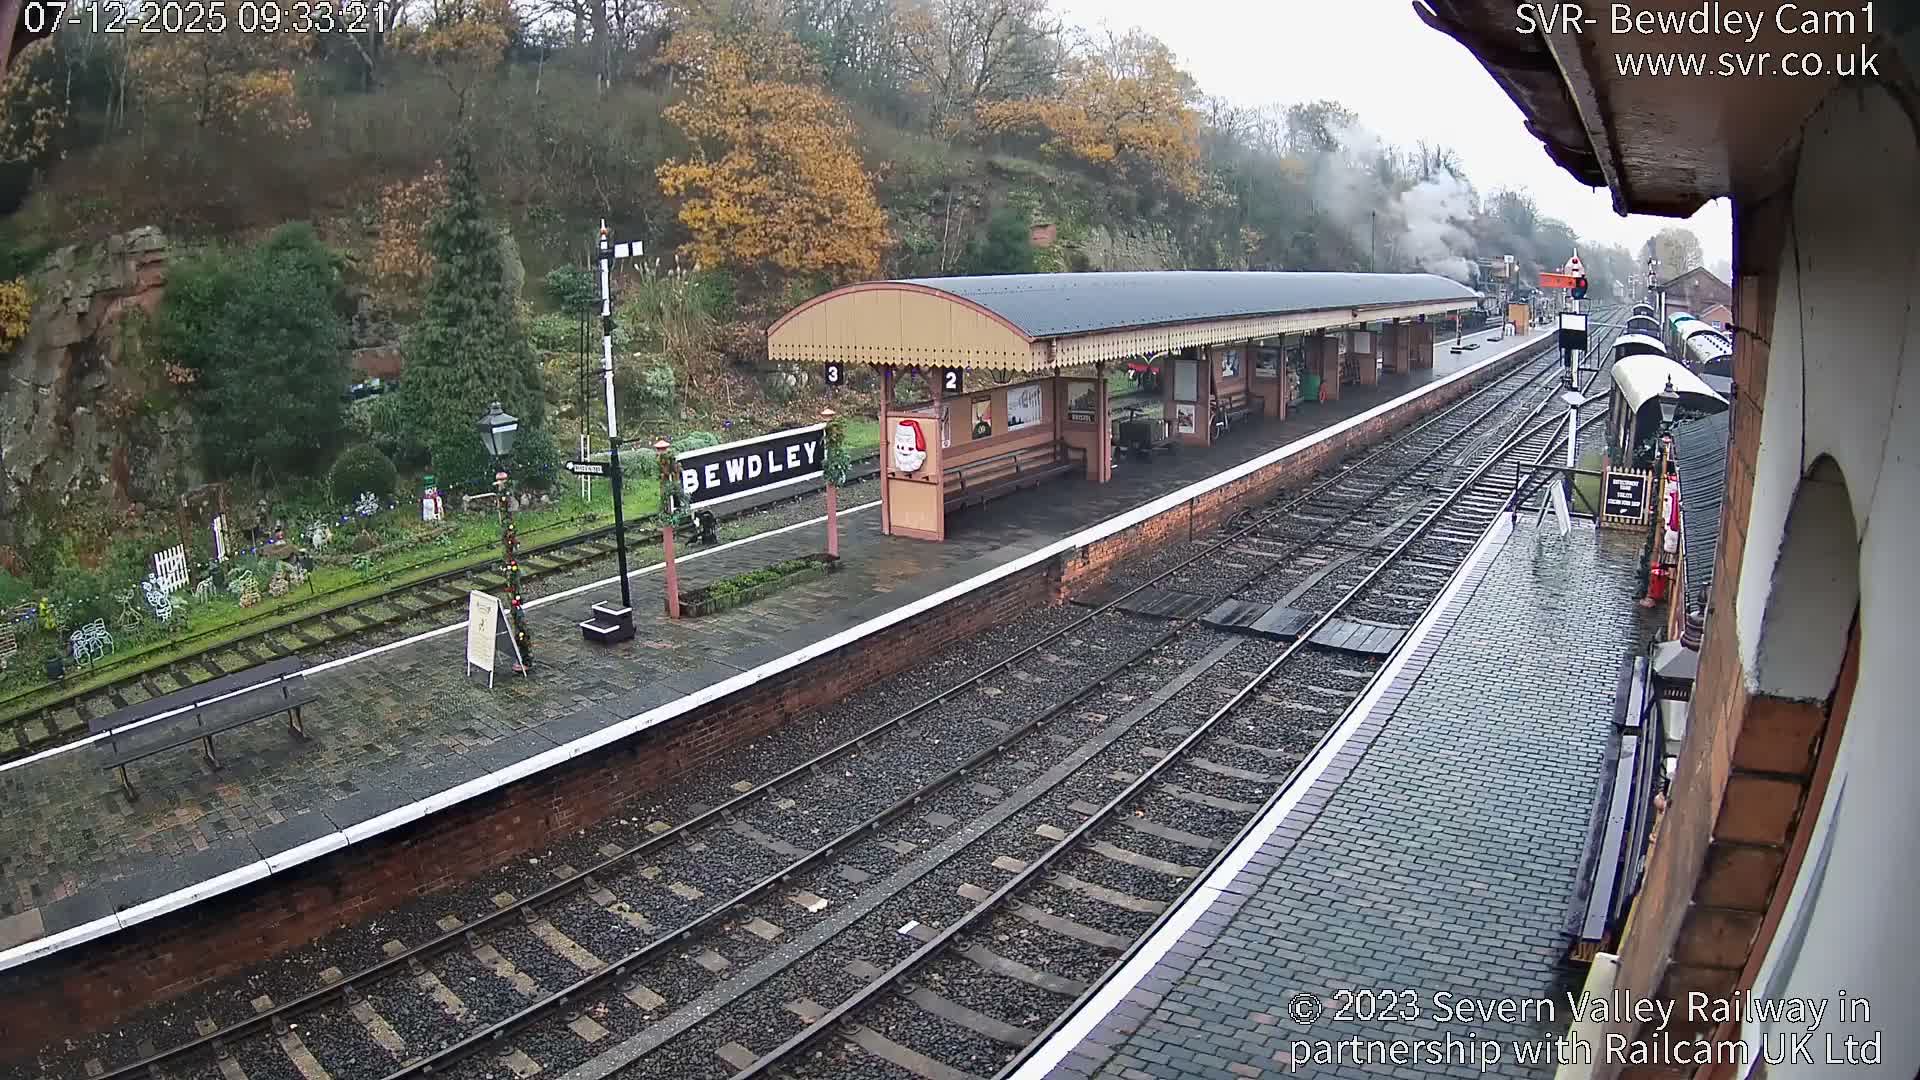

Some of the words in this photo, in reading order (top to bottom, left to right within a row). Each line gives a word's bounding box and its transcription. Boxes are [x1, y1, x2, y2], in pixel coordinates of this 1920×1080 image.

[828, 366, 838, 382] 3
[945, 372, 957, 389] 2
[681, 441, 817, 495] BEWDLEY
